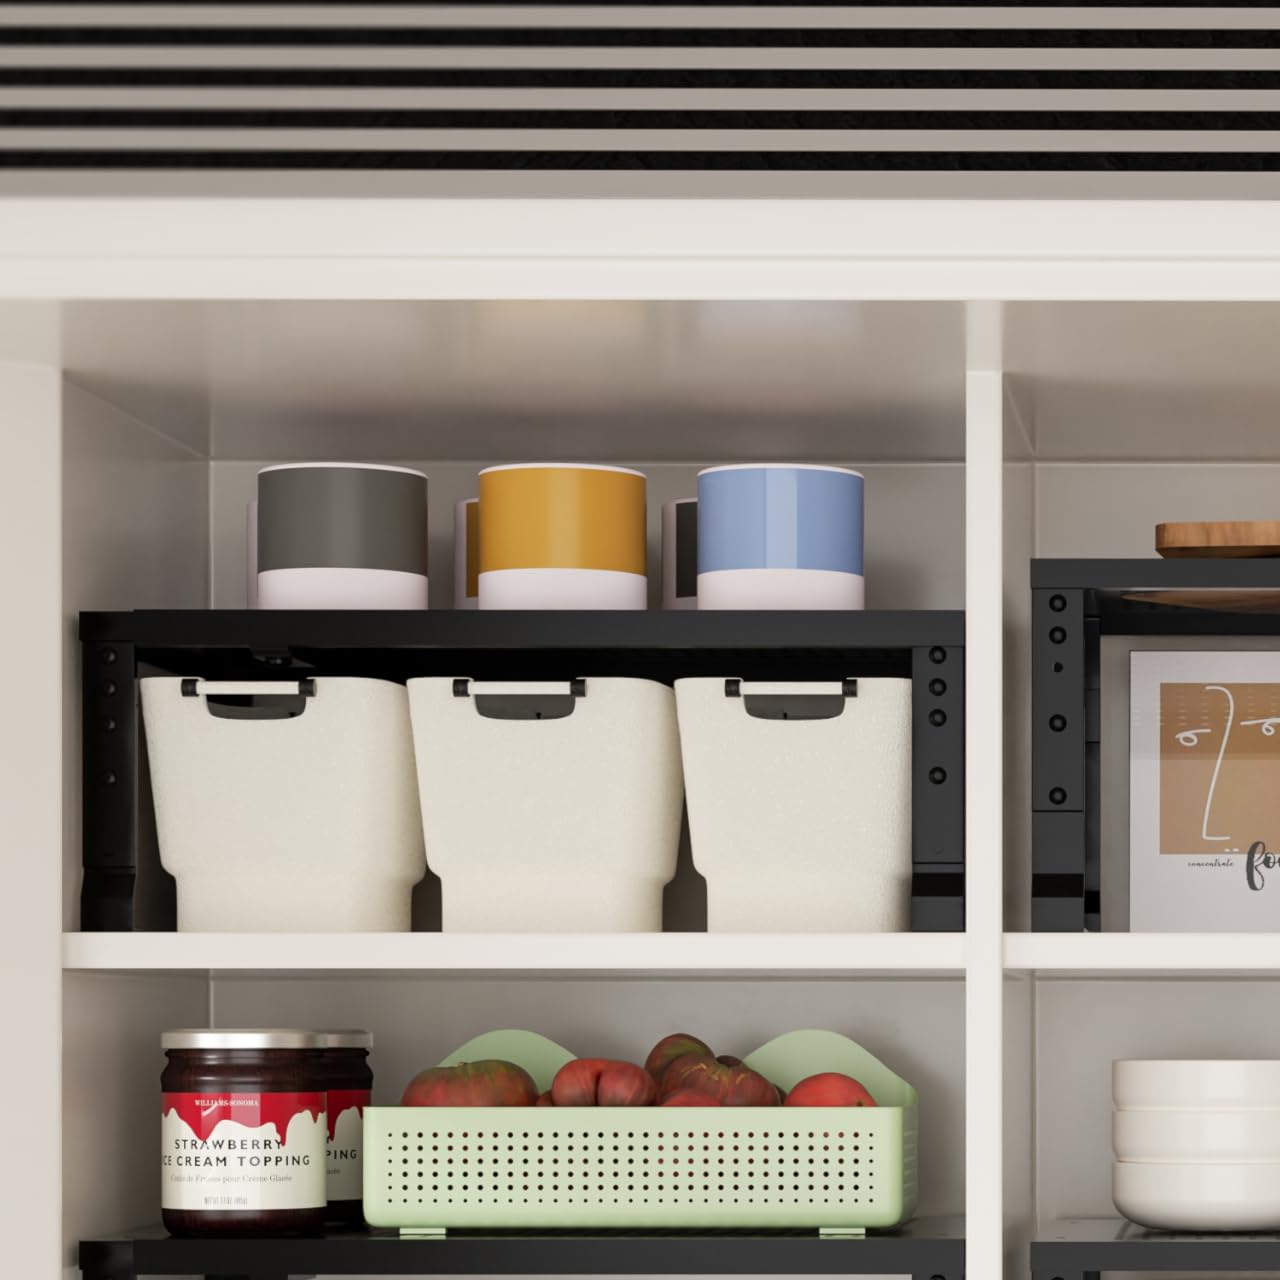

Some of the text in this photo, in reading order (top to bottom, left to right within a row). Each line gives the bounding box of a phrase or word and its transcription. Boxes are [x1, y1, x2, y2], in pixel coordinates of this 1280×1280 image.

[174, 1139, 282, 1150] STRAWBERRY
[161, 1155, 311, 1167] CE CREAM TOPPING
